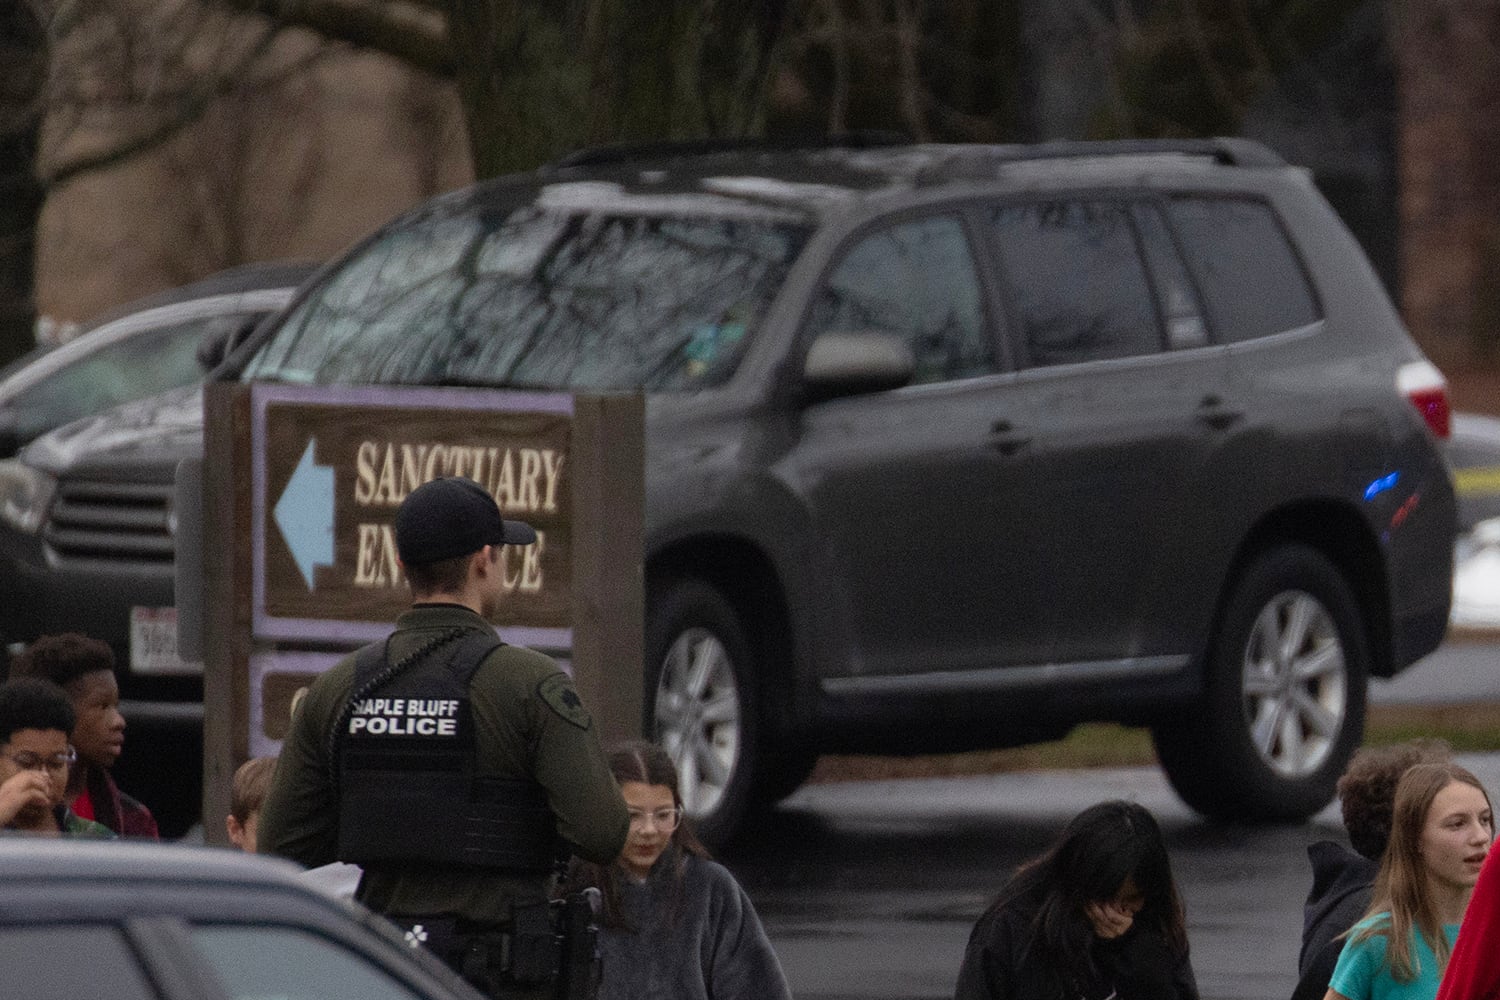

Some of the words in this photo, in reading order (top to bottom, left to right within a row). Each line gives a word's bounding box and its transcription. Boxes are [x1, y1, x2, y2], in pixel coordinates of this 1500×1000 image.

[354, 524, 545, 592] ENCE
[407, 700, 459, 716] BLUFF
[349, 717, 457, 735] POLICE
